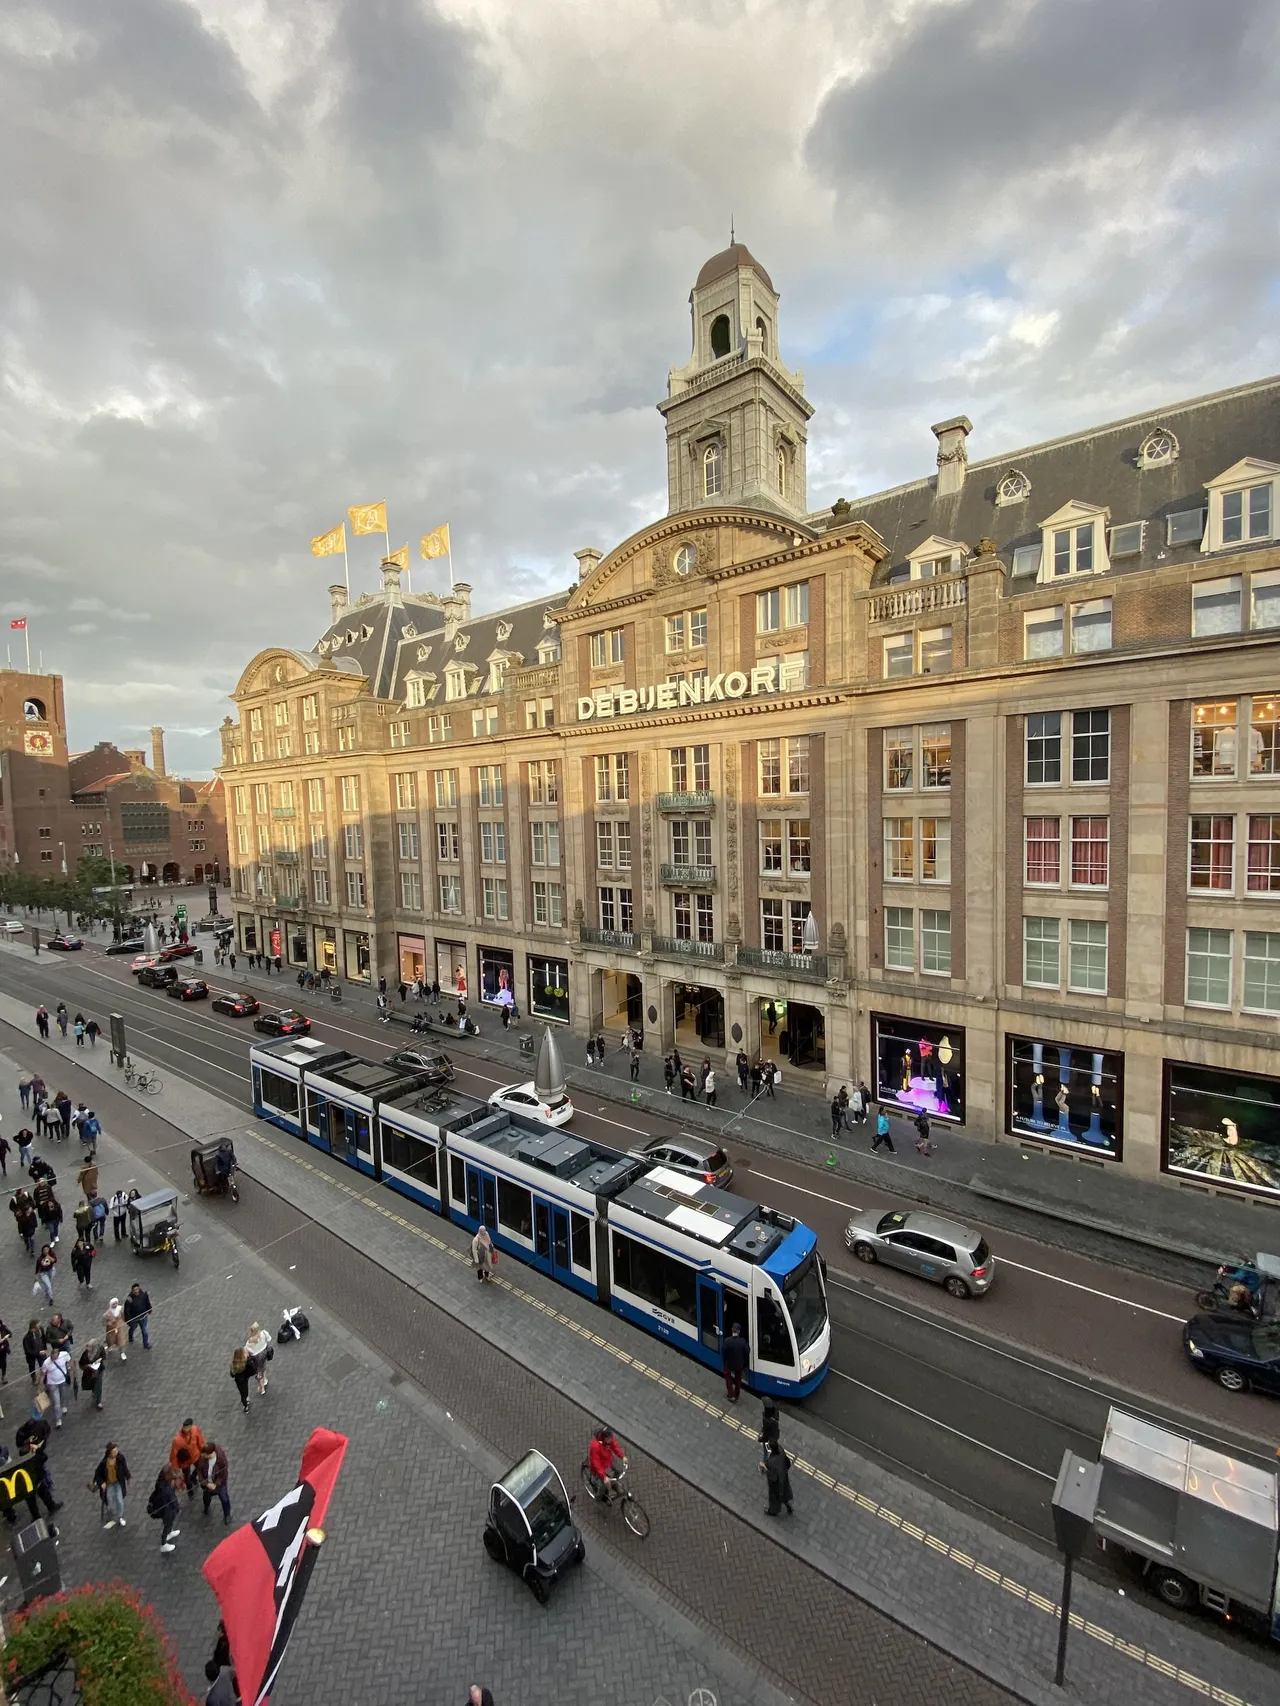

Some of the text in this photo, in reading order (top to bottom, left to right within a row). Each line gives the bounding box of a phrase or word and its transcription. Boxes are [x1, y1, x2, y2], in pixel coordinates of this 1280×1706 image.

[578, 659, 805, 720] DE BIJENKORF
[1019, 1116, 1036, 1124] FUTURE
